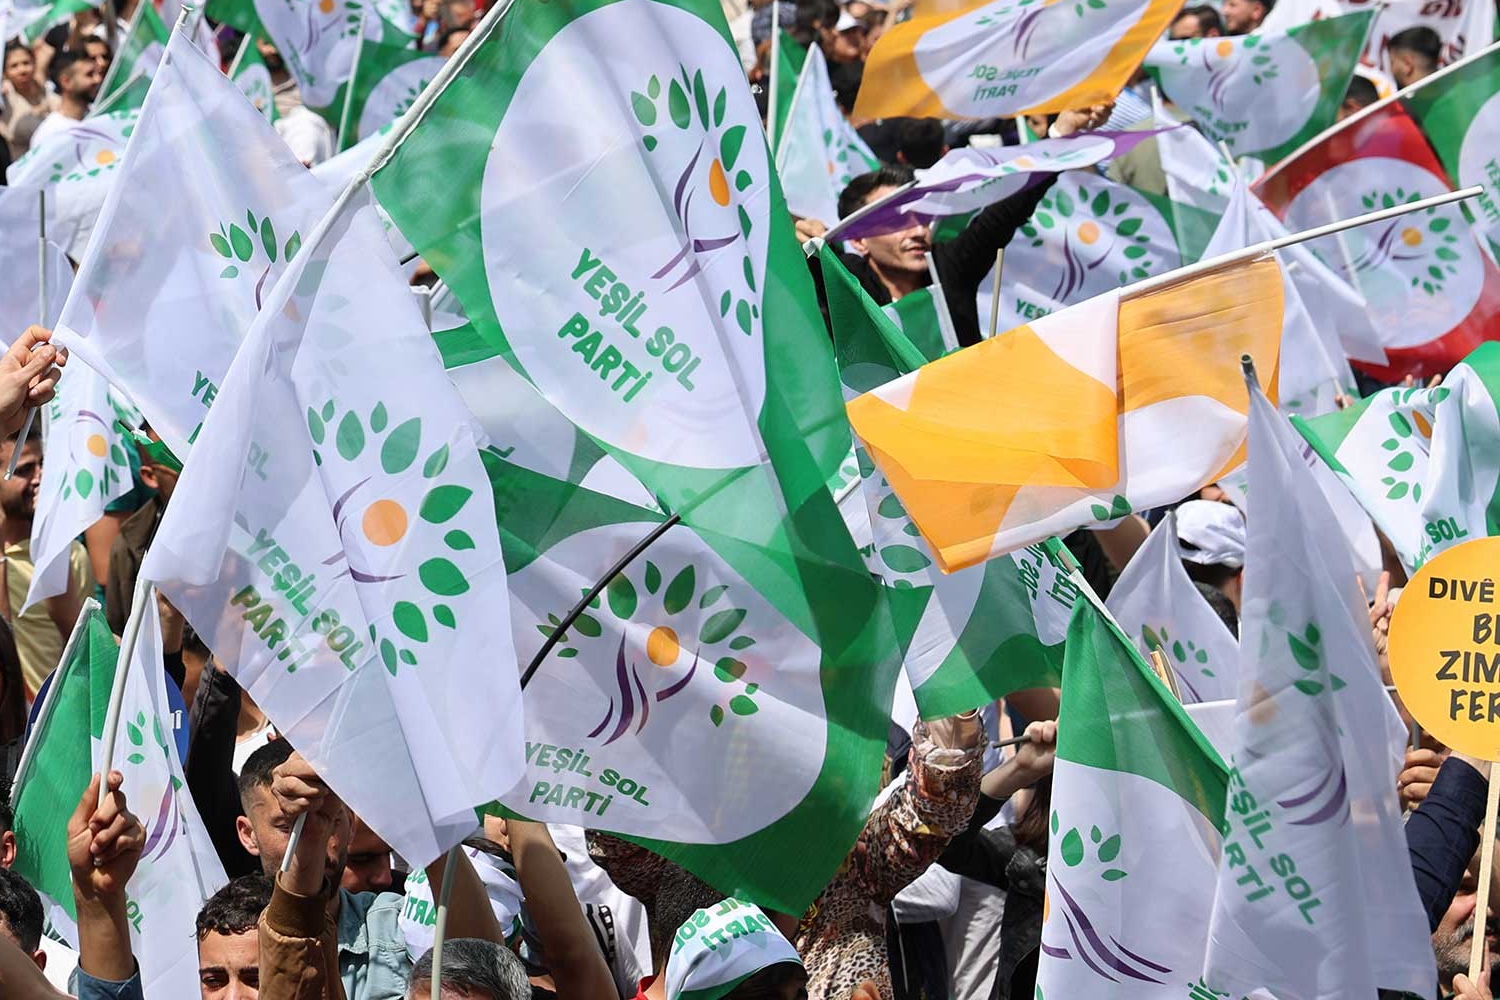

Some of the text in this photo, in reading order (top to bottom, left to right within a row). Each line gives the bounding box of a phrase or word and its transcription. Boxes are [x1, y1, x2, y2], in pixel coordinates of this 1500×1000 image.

[571, 247, 701, 391] YEŞİL SOL
[557, 311, 653, 403] PARTİ
[1425, 517, 1468, 545] SOL
[247, 528, 364, 672] YEŞİL SOL
[1428, 576, 1495, 603] DIVÊ
[525, 741, 650, 806] YEŞİL SOL
[529, 781, 614, 816] PARTİ
[1269, 852, 1322, 925] SOL
